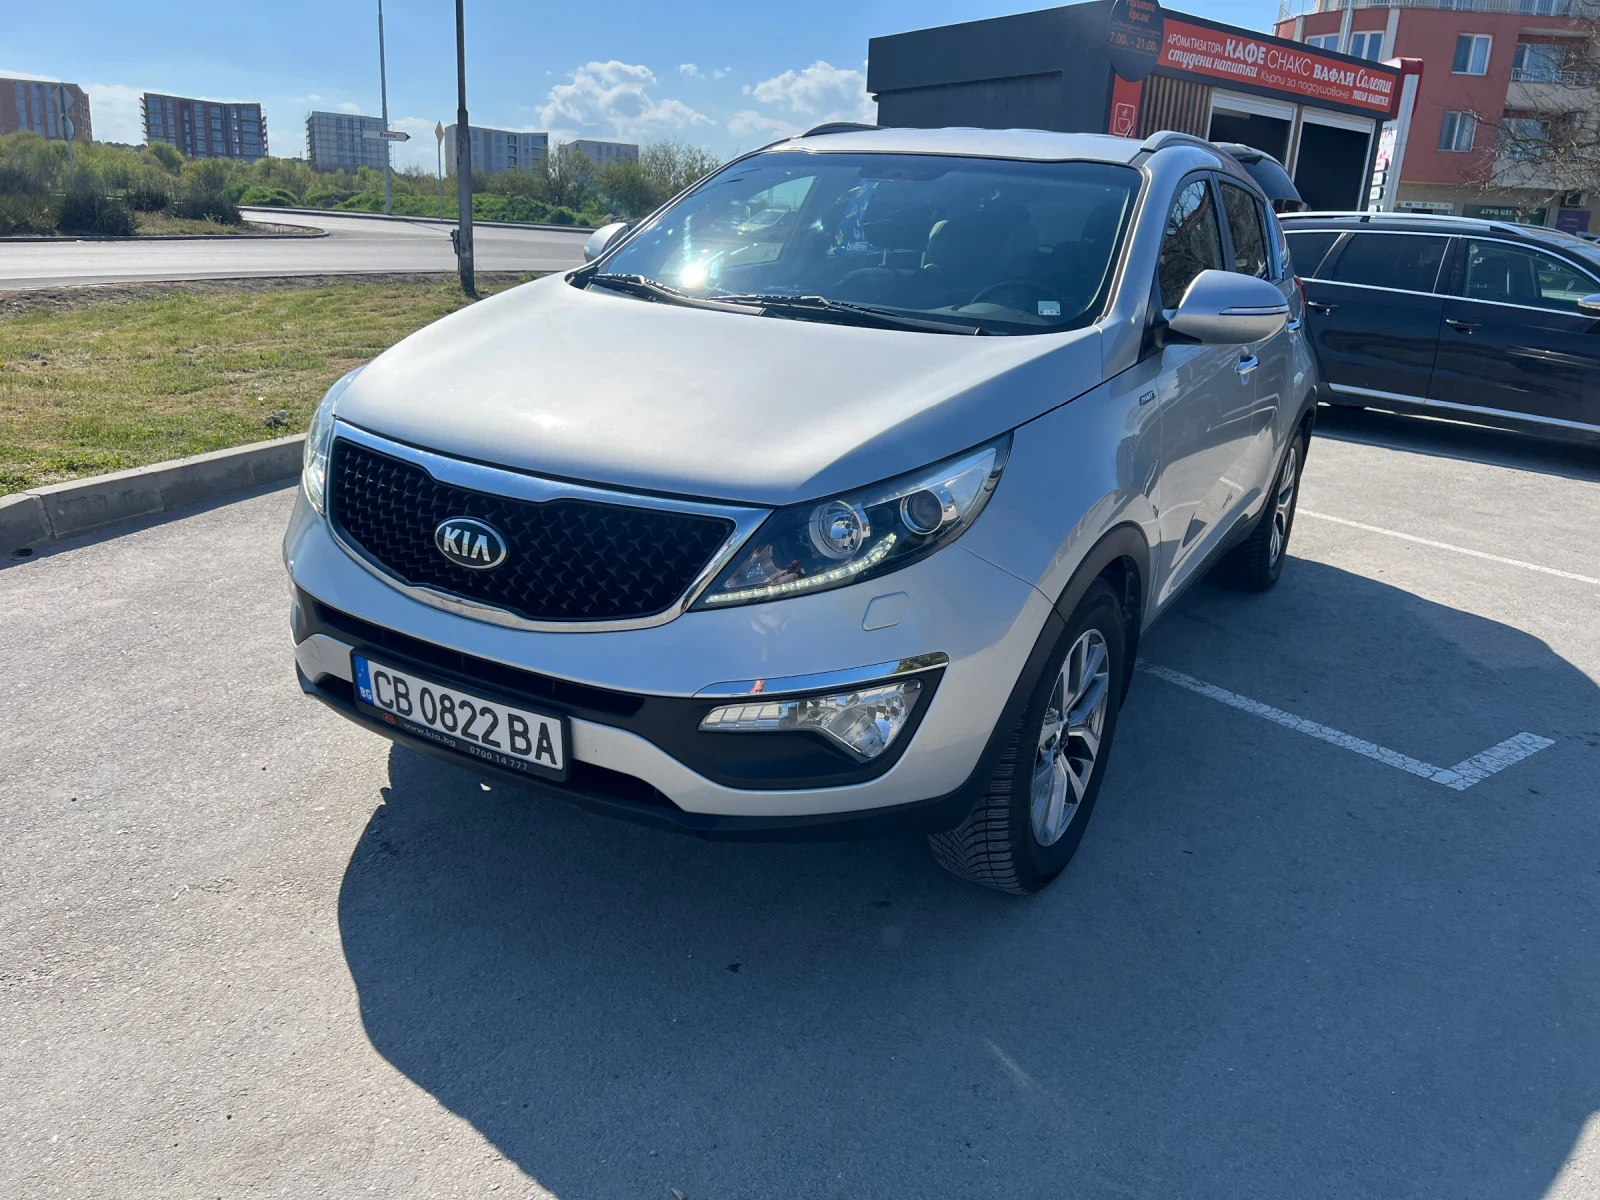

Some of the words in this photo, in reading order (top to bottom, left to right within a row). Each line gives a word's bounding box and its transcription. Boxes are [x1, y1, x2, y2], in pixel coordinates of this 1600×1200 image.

[1167, 33, 1224, 55] АРОМАТИЗАТОРИ
[1225, 38, 1266, 65] КАФЕ
[1267, 50, 1312, 76] СНАКС
[1313, 63, 1355, 87] ВАФЛИ
[1356, 69, 1392, 93] Солети
[1168, 48, 1213, 69] студени
[1213, 58, 1258, 78] напитки
[1260, 70, 1285, 85] Кърпи
[1286, 77, 1296, 87] за
[1297, 80, 1350, 99] подсушаване
[443, 526, 491, 562] KIA
[359, 686, 372, 700] BG
[403, 722, 456, 748] www.kia.bg
[470, 746, 492, 760] 0700
[495, 754, 507, 765] 14
[510, 759, 528, 771] 777
